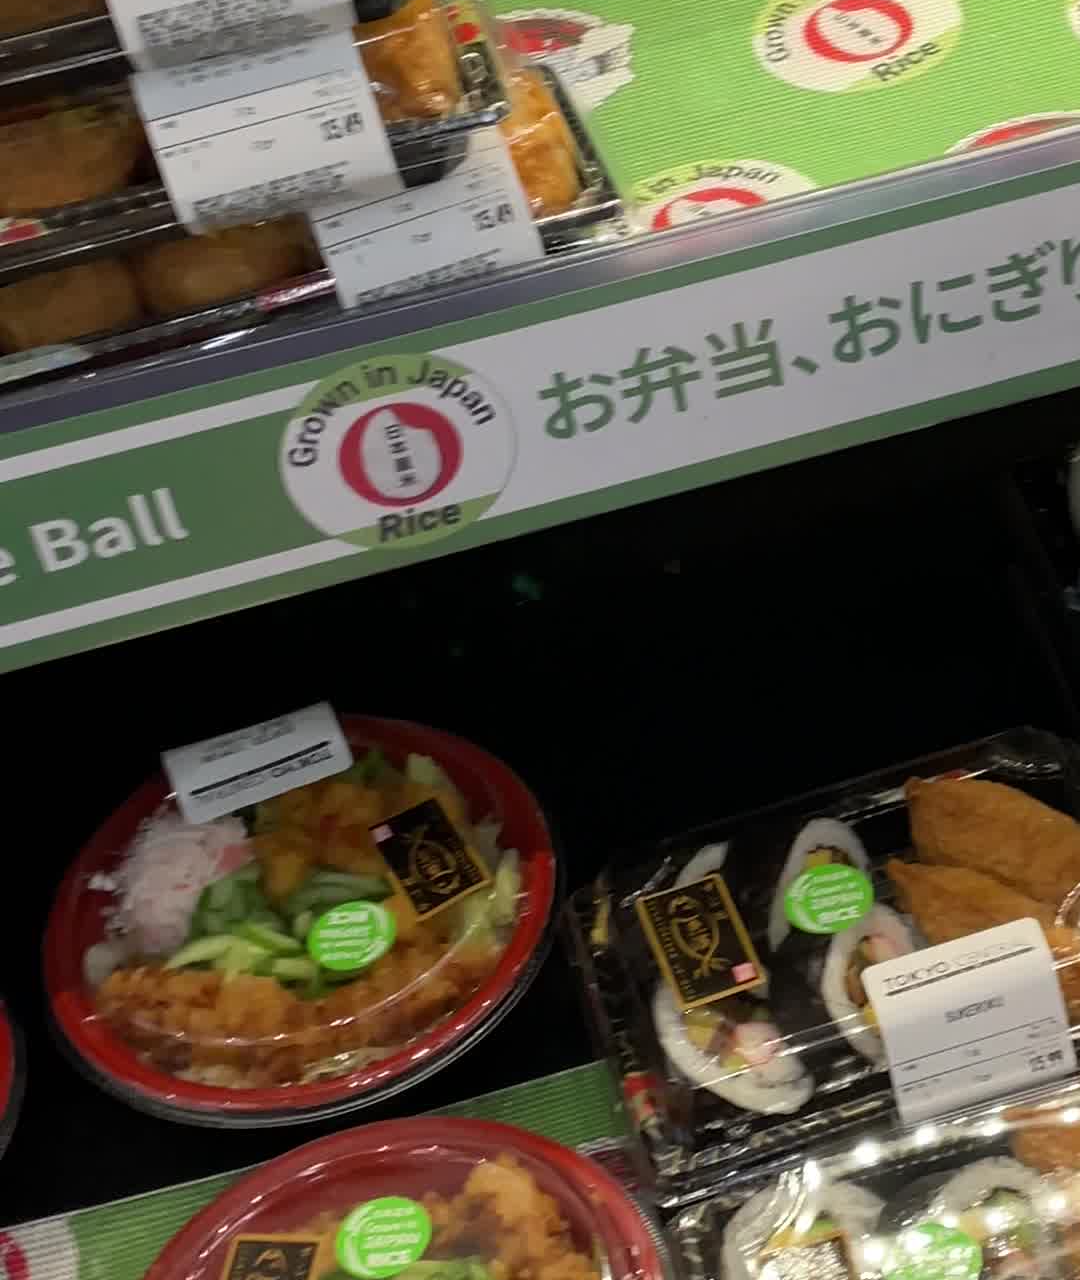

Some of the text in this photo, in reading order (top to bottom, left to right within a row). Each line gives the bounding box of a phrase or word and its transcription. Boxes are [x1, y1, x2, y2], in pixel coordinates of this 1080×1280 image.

[871, 42, 940, 81] Rice
[689, 163, 785, 185] Japan
[288, 360, 497, 468] Grown in Japan
[28, 487, 190, 575] Ball
[378, 503, 462, 543] Rice
[882, 961, 948, 991] TOKYO
